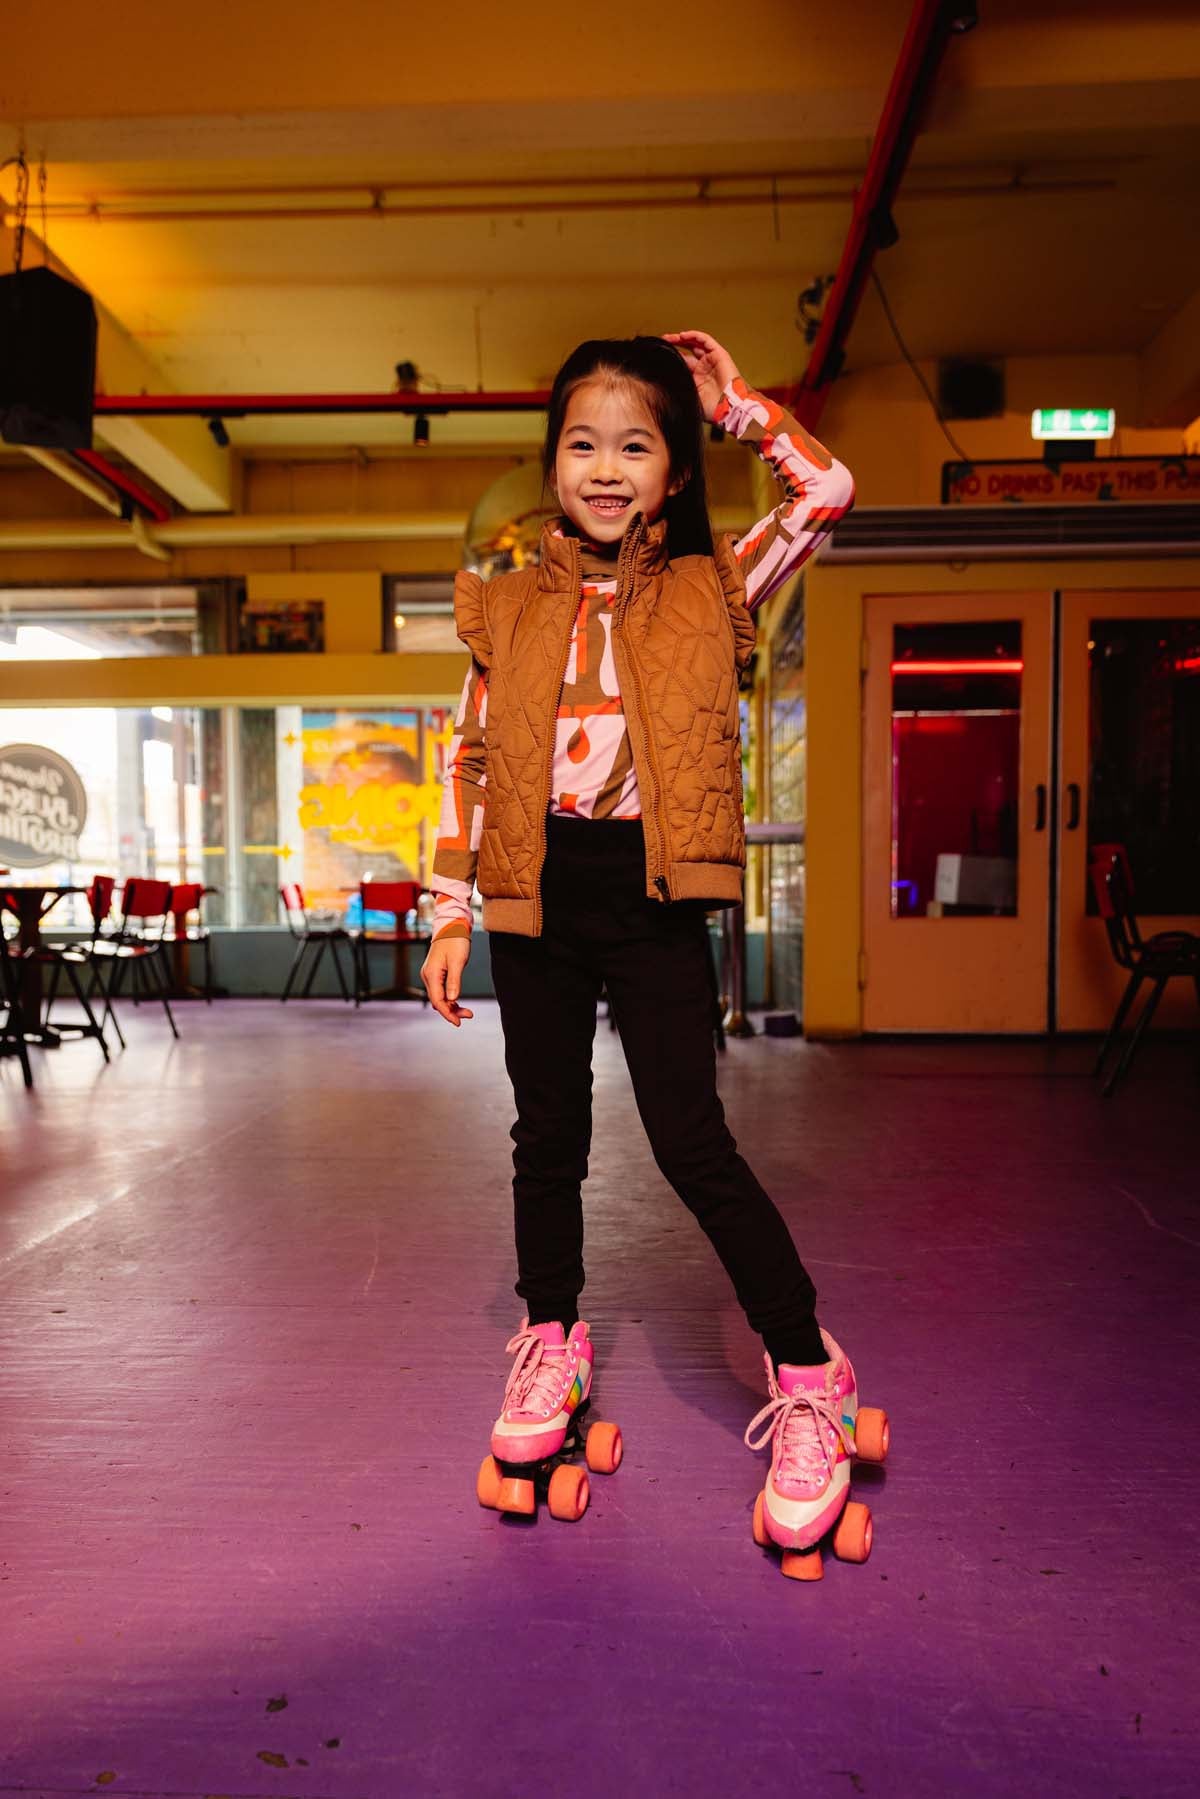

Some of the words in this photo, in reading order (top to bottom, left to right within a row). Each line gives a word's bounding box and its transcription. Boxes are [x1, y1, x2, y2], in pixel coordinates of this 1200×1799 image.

[951, 476, 982, 497] NO
[987, 474, 1055, 496] DRINKS
[1062, 472, 1109, 493] PAST
[1117, 471, 1158, 492] THIS
